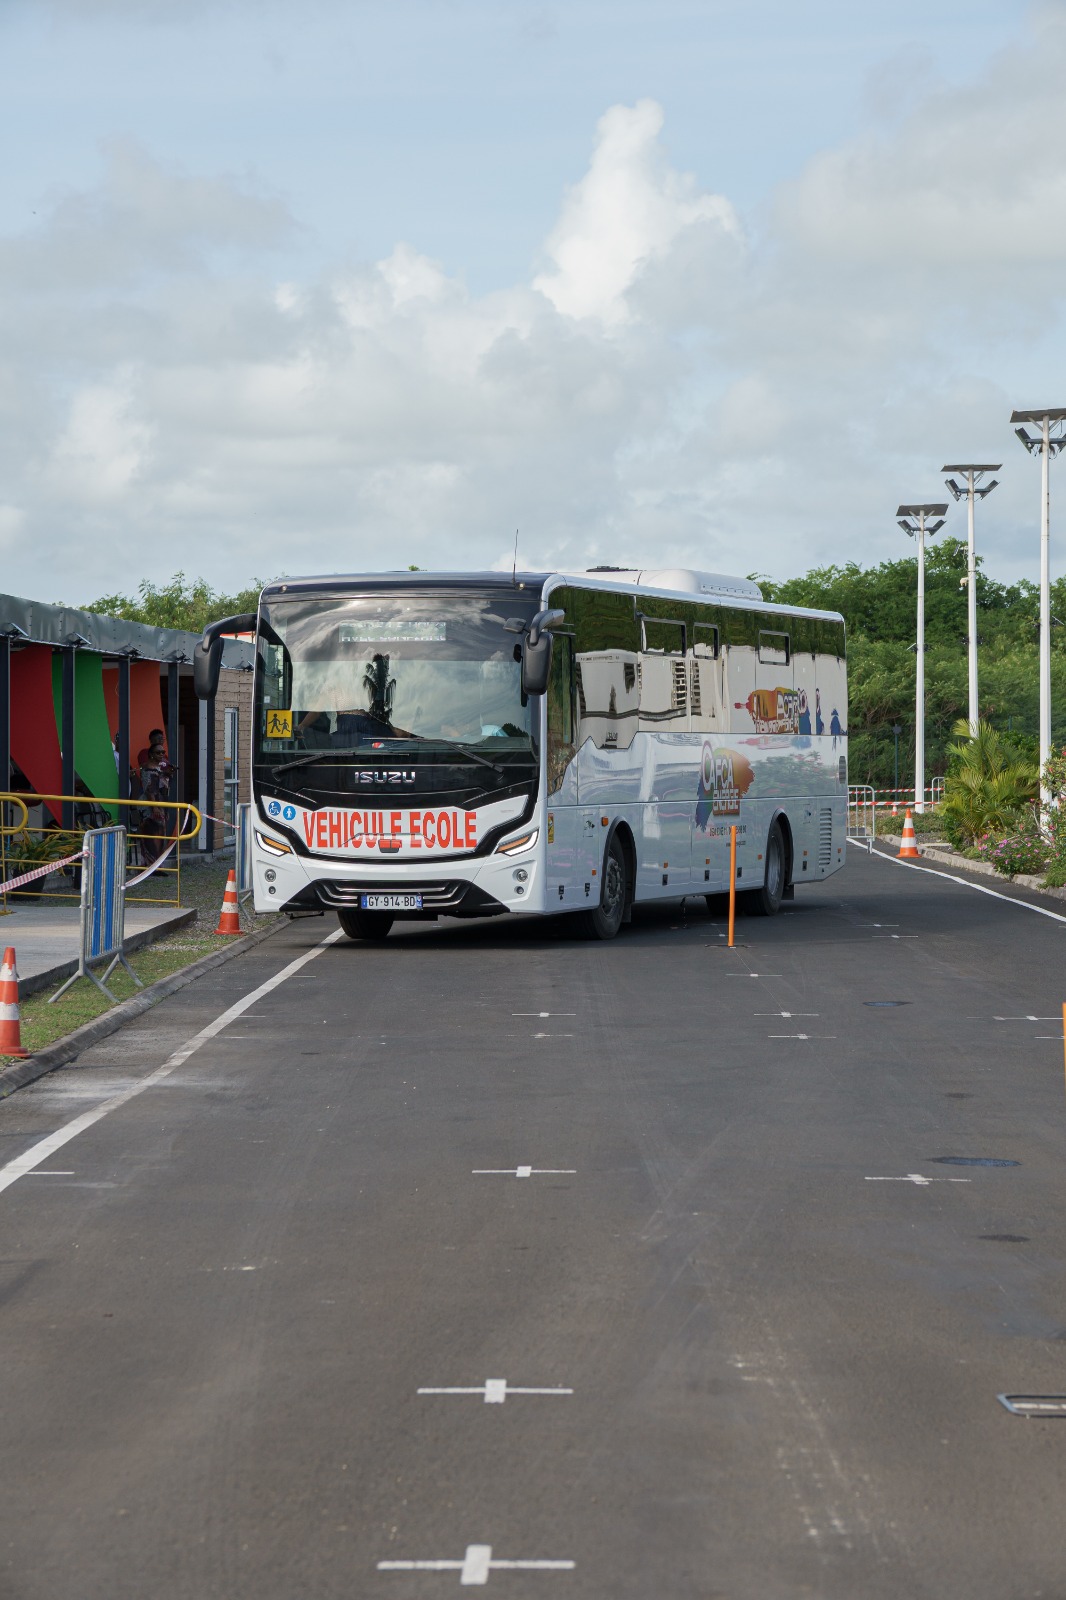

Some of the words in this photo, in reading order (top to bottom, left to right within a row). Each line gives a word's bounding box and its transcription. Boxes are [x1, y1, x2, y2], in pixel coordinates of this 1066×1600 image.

[354, 771, 416, 784] ISUZU
[303, 811, 403, 848] VEHICULE
[409, 811, 477, 848] ECOLE
